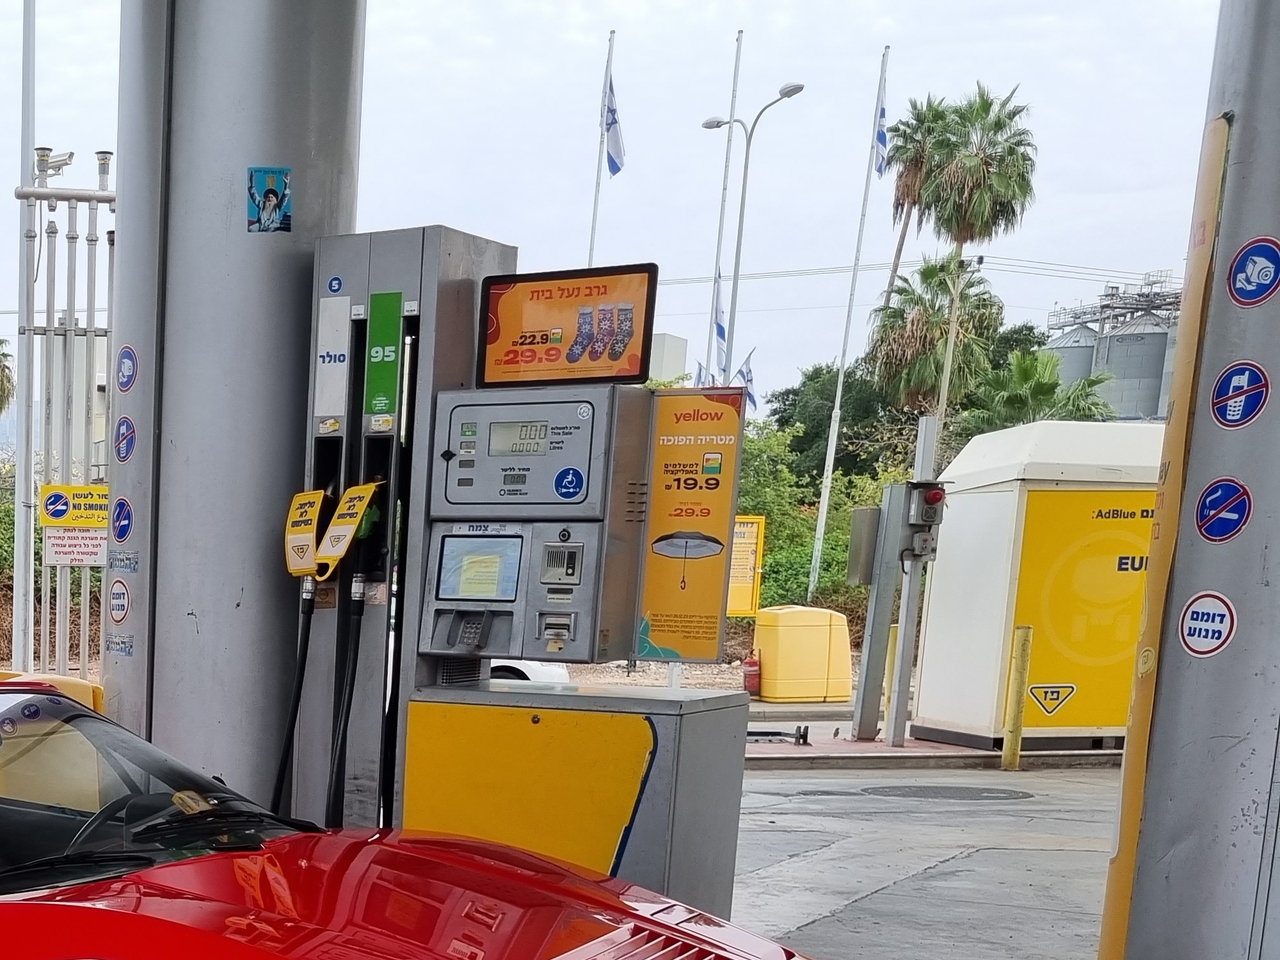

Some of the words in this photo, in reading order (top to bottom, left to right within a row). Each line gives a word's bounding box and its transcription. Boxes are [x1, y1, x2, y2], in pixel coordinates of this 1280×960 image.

[331, 280, 339, 290] 5
[584, 284, 608, 297] גרב
[529, 288, 553, 301] בית
[558, 286, 580, 299] נעל
[319, 351, 346, 364] סולר
[370, 346, 396, 363] 95
[674, 409, 724, 424] yellow
[660, 436, 694, 445] הפוכה
[698, 435, 734, 445] מטריה
[72, 491, 94, 500] לעשן
[72, 503, 82, 511] NO
[347, 503, 356, 511] לא
[299, 509, 308, 518] לא
[468, 524, 489, 532] צמח
[1117, 556, 1149, 572] EU
[1190, 610, 1226, 624] דומם
[1187, 626, 1222, 640] מנוע
[1043, 689, 1061, 701] פז
